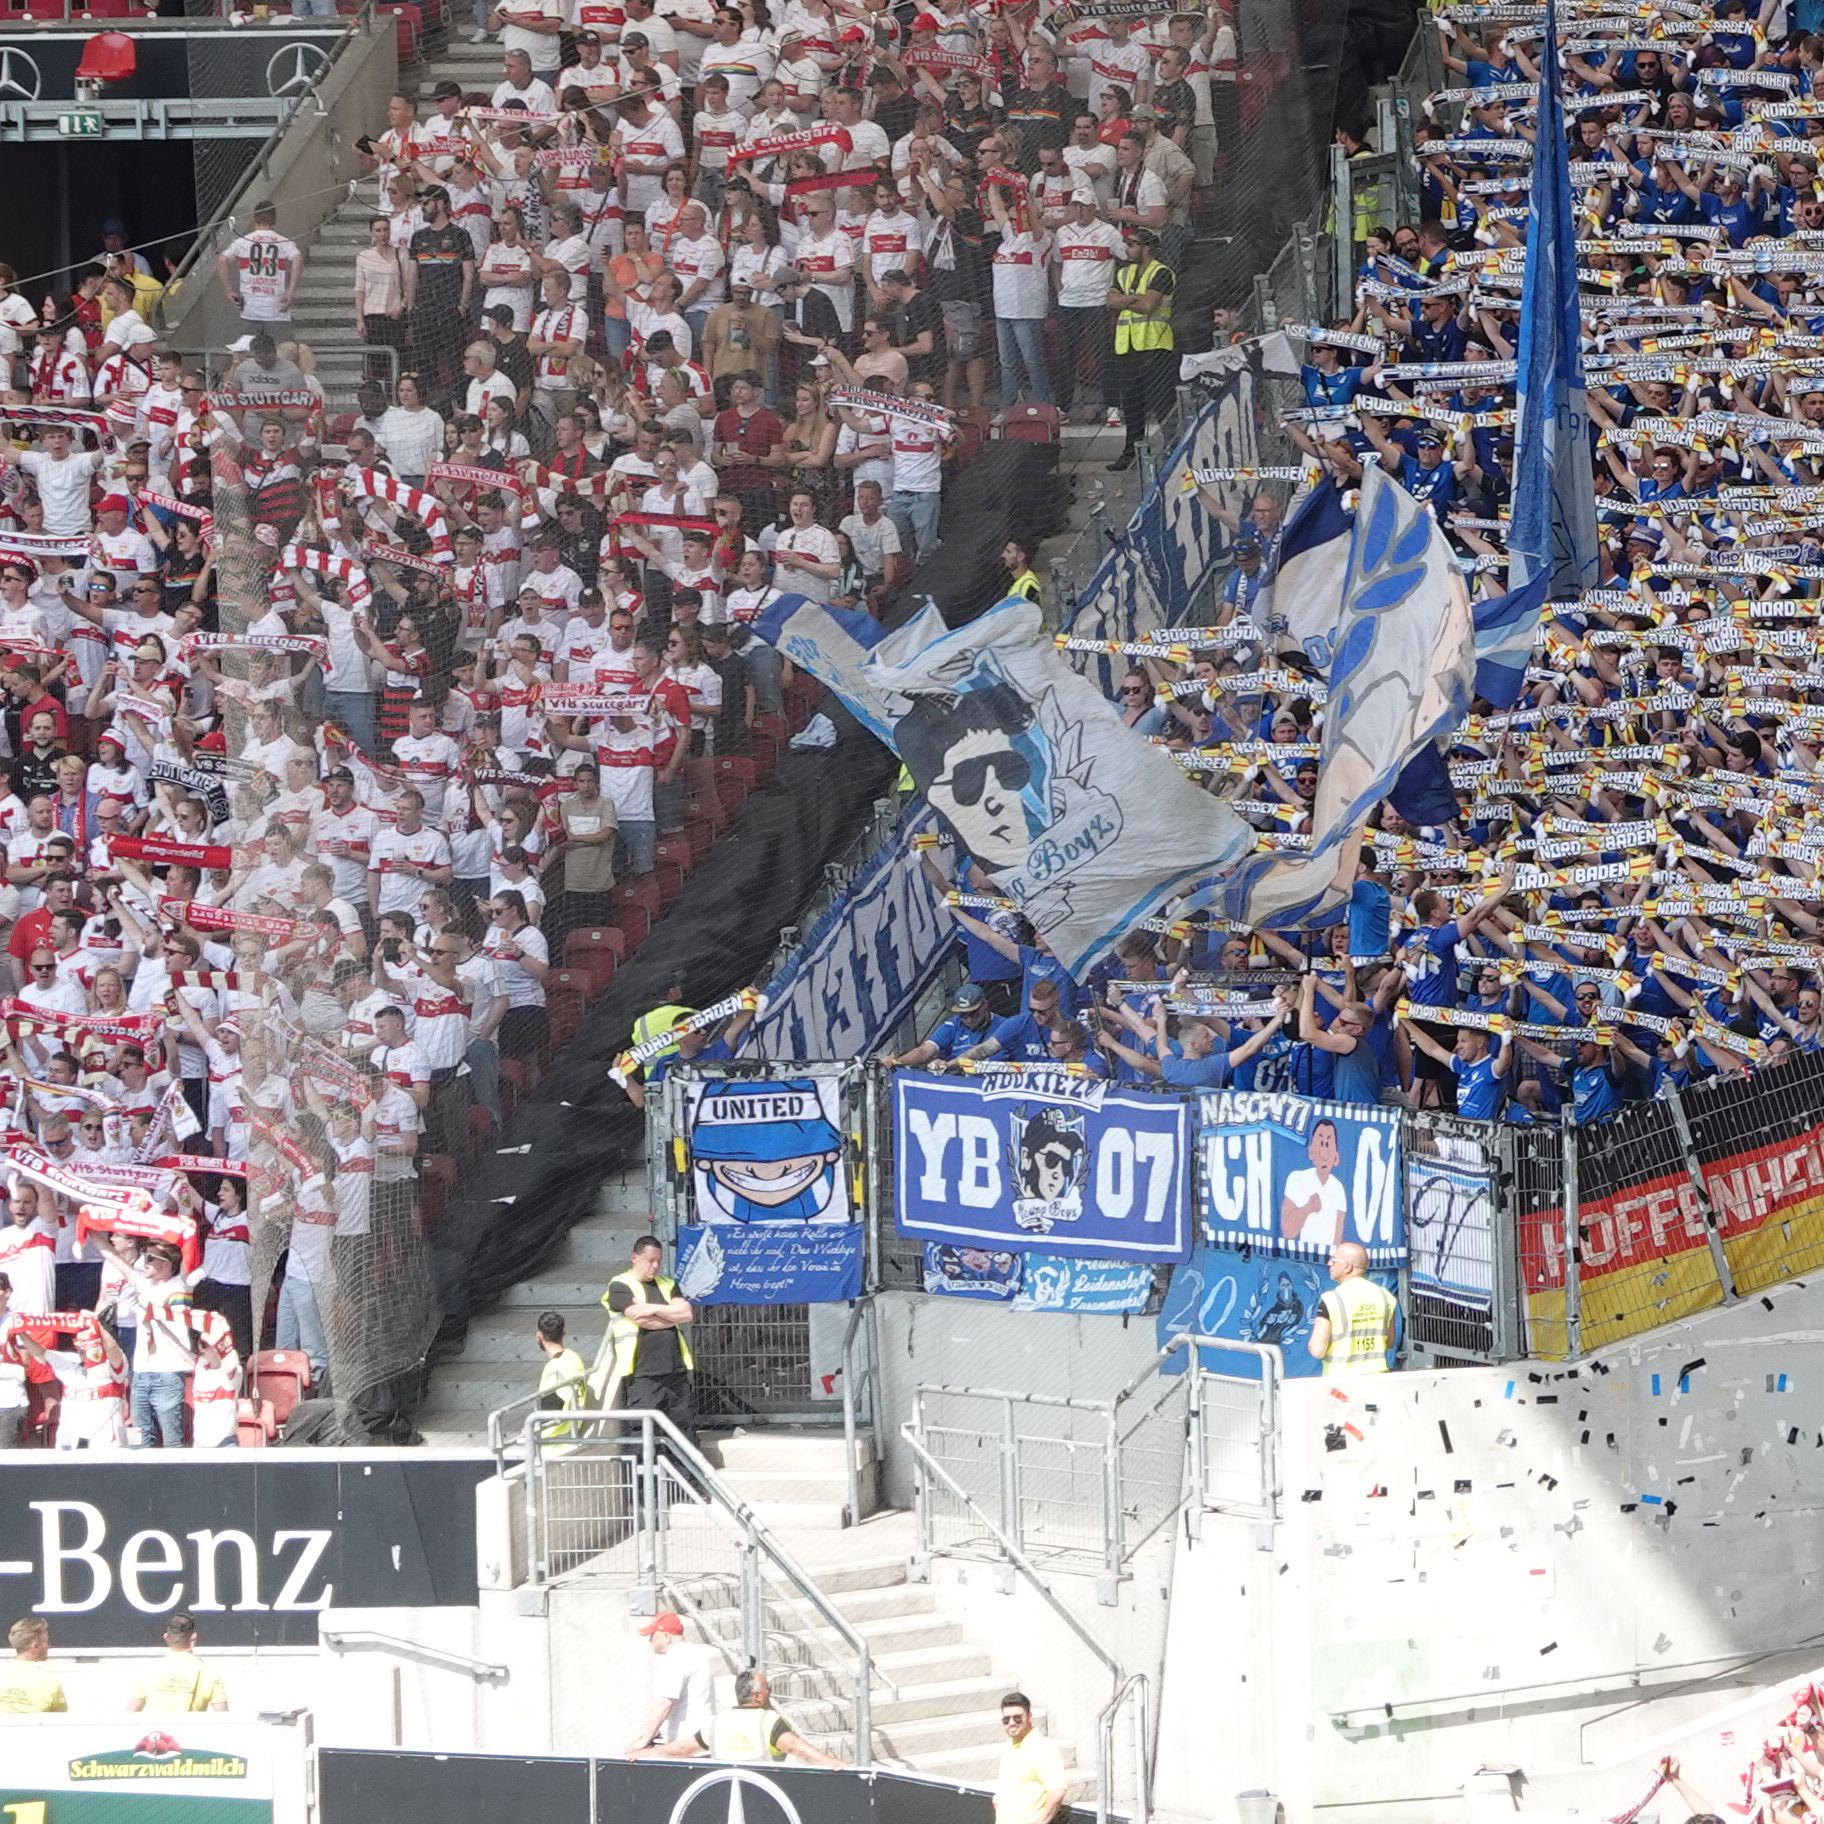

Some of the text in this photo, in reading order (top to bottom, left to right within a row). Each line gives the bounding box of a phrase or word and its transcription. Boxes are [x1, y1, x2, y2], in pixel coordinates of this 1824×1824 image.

[1114, 0, 1176, 16] Stuttgart
[1663, 21, 1753, 35] NORD BADEN
[249, 242, 279, 277] 93
[1441, 362, 1517, 377] HOFFENHEIM
[1749, 600, 1796, 617] NORD
[578, 696, 648, 714] Stuttgart
[1543, 746, 1663, 766] NORD BADEN
[1541, 829, 1657, 860] NORD BADEN
[1574, 861, 1630, 883] BADEN
[1657, 900, 1748, 916] NORD BADEN
[629, 995, 741, 1065] NORD BADEN
[712, 1095, 804, 1121] UNITED
[909, 1108, 1174, 1224] YB 07
[1356, 1338, 1375, 1351] 1155
[70, 1757, 245, 1778] Schwarzwaldmilch
